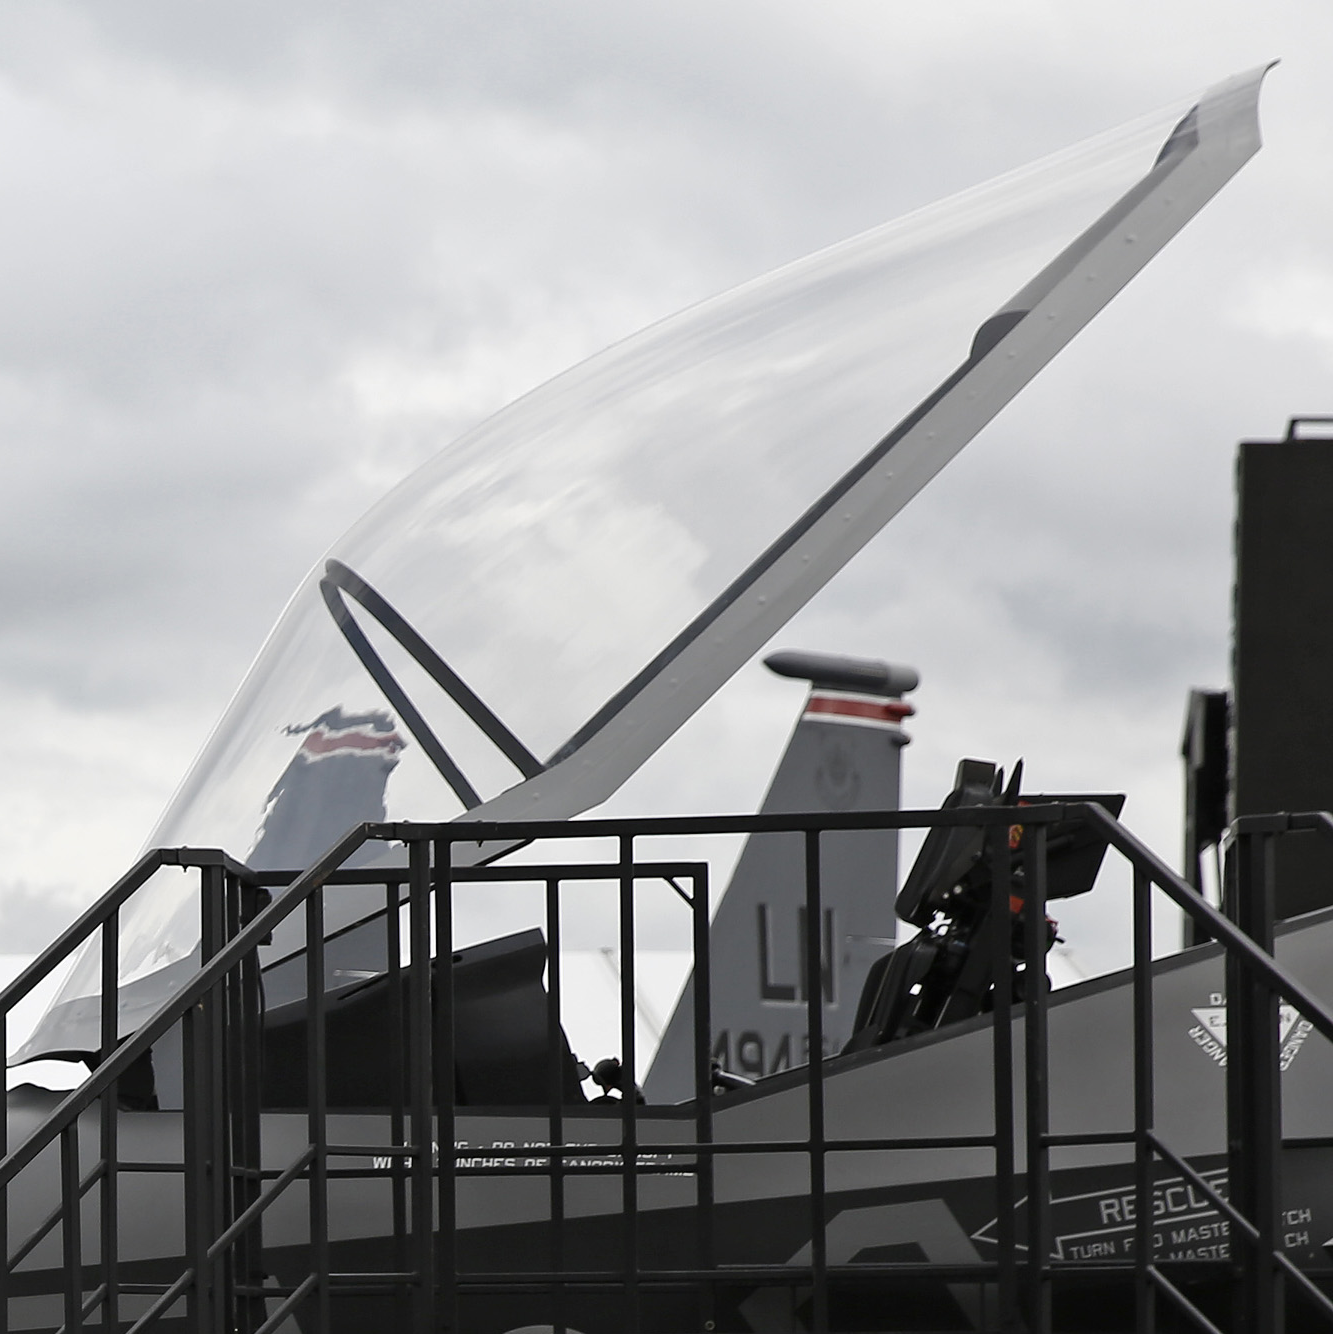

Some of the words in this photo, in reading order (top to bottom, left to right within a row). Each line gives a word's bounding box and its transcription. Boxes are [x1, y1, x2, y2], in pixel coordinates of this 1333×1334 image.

[757, 903, 834, 1002] LN
[1187, 1024, 1227, 1068] ANGER
[1071, 1242, 1115, 1260] TURN
[1172, 1221, 1229, 1245] MASTE
